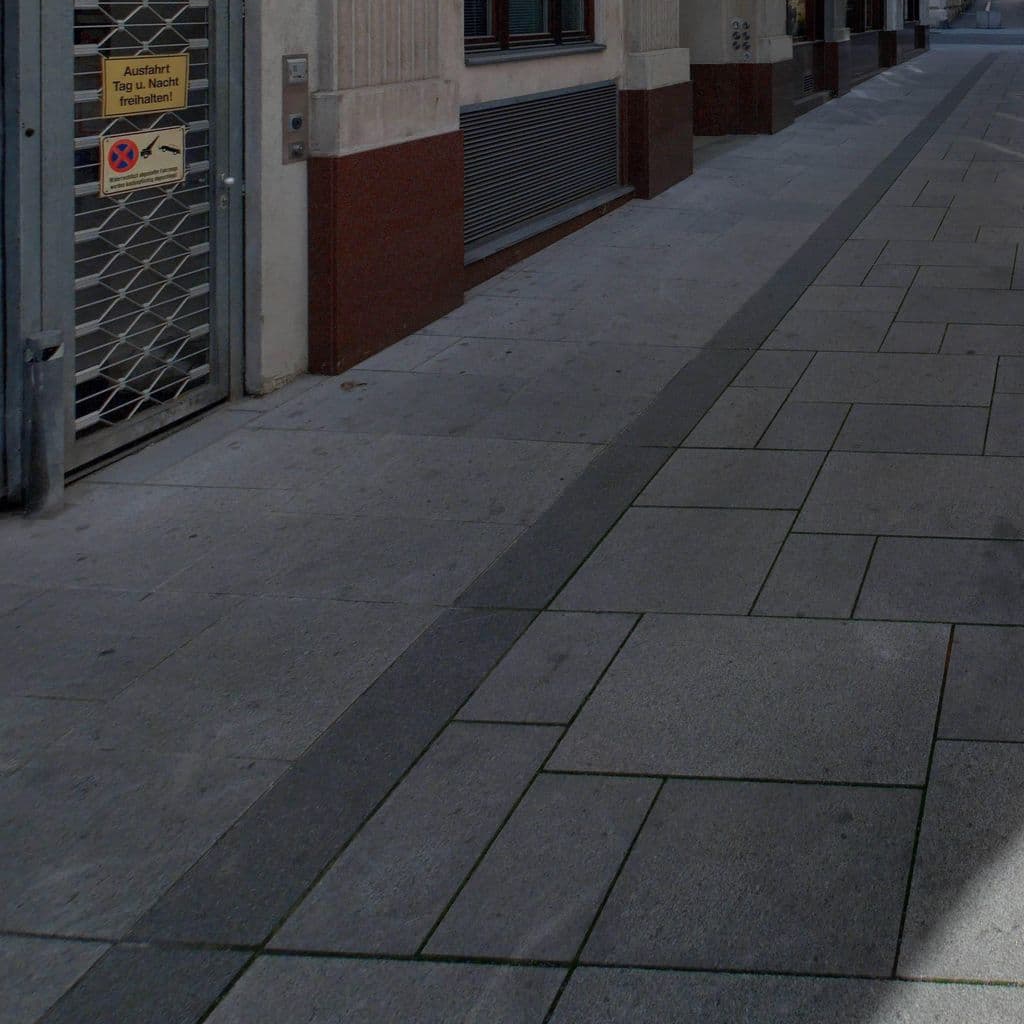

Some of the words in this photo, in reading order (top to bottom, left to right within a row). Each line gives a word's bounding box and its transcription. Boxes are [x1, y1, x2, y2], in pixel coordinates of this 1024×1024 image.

[123, 64, 171, 77] Ausfahrt
[112, 80, 133, 93] Tag
[136, 82, 146, 90] u.
[148, 77, 179, 89] Nacht
[120, 91, 173, 107] freihalten!
